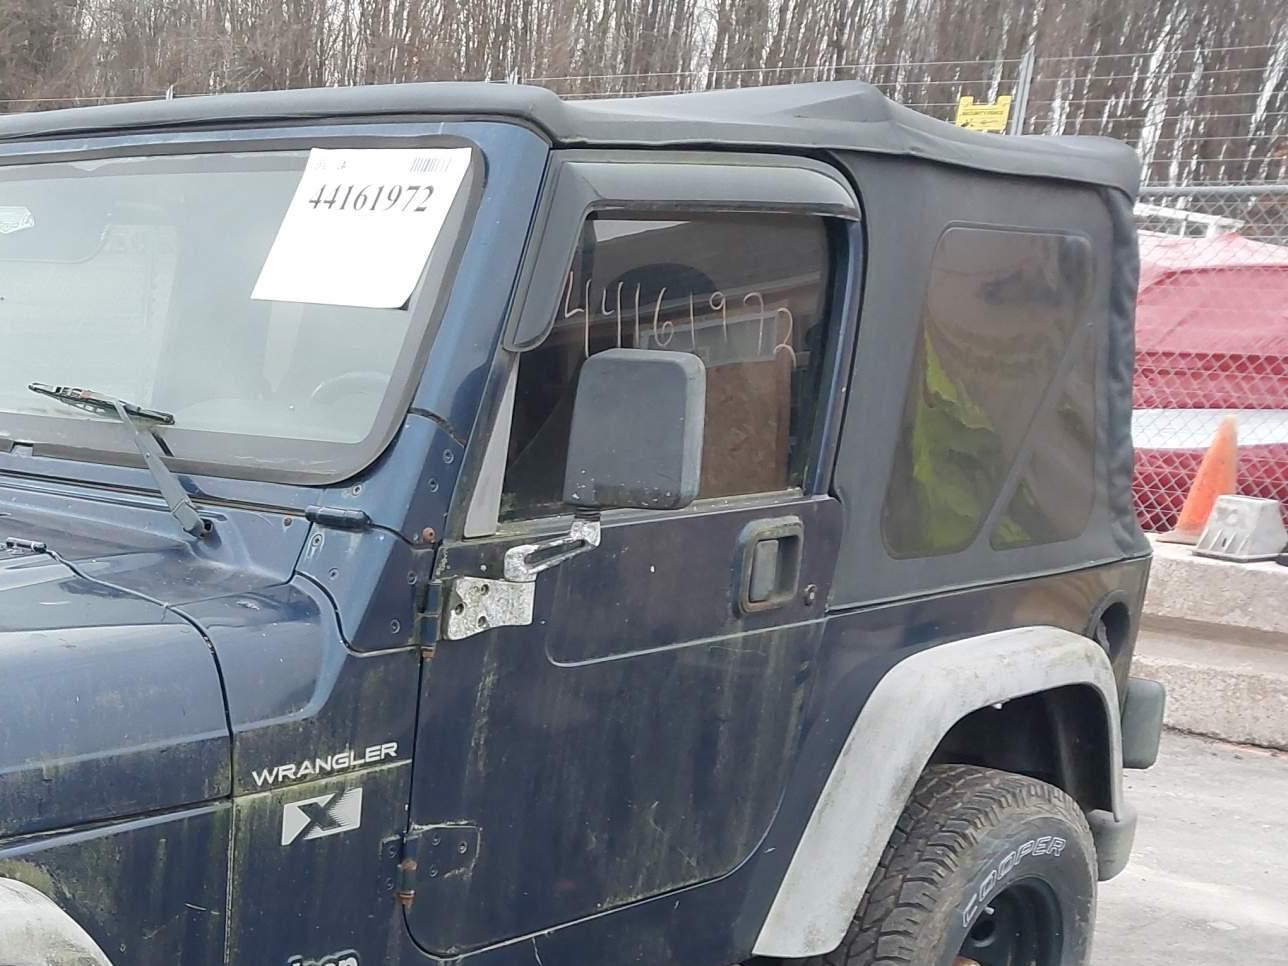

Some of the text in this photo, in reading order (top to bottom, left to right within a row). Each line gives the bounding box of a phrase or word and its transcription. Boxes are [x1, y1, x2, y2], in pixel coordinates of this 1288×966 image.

[308, 183, 435, 212] 44161972
[251, 741, 398, 787] WRANGLER
[962, 835, 1066, 928] COOPER
